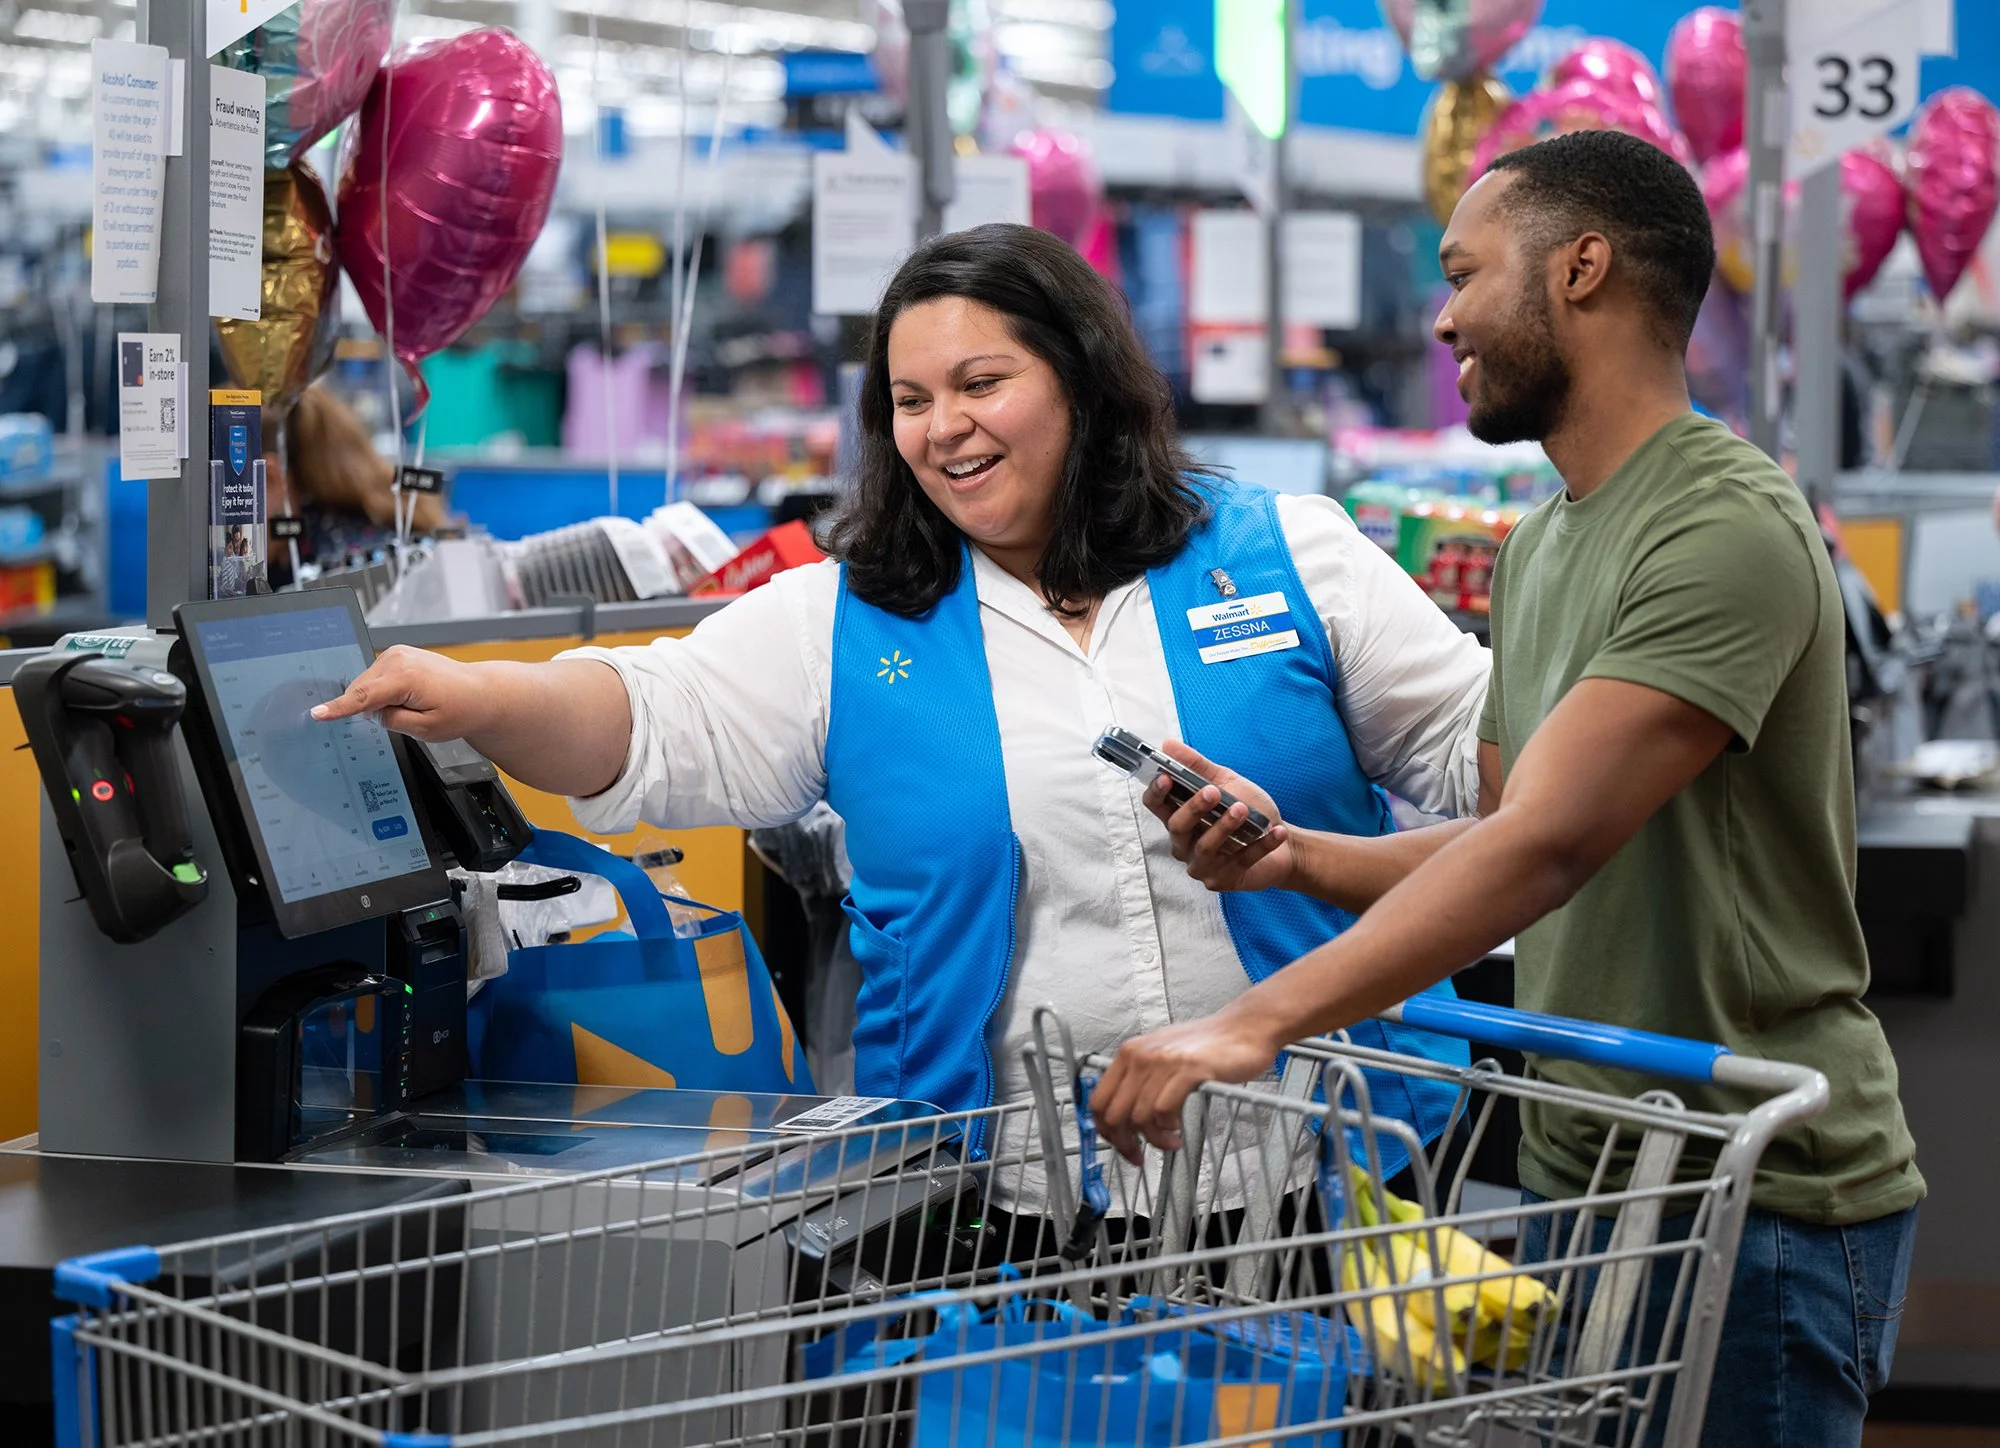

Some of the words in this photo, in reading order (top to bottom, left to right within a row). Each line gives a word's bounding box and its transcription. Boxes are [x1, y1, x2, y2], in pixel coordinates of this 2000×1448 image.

[102, 72, 125, 86] Alcohol
[1813, 53, 1897, 119] 33
[109, 96, 135, 106] customers
[215, 98, 235, 114] Fraud
[236, 104, 260, 124] warning
[214, 118, 240, 131] Advertencia
[240, 124, 246, 132] de
[121, 149, 136, 161] proof
[149, 348, 163, 362] Earn
[165, 348, 175, 362] 2%
[148, 366, 175, 380] in-store
[1211, 607, 1250, 622] Walmart
[1213, 620, 1271, 641] ZESSNA
[1249, 635, 1288, 650] Difference
